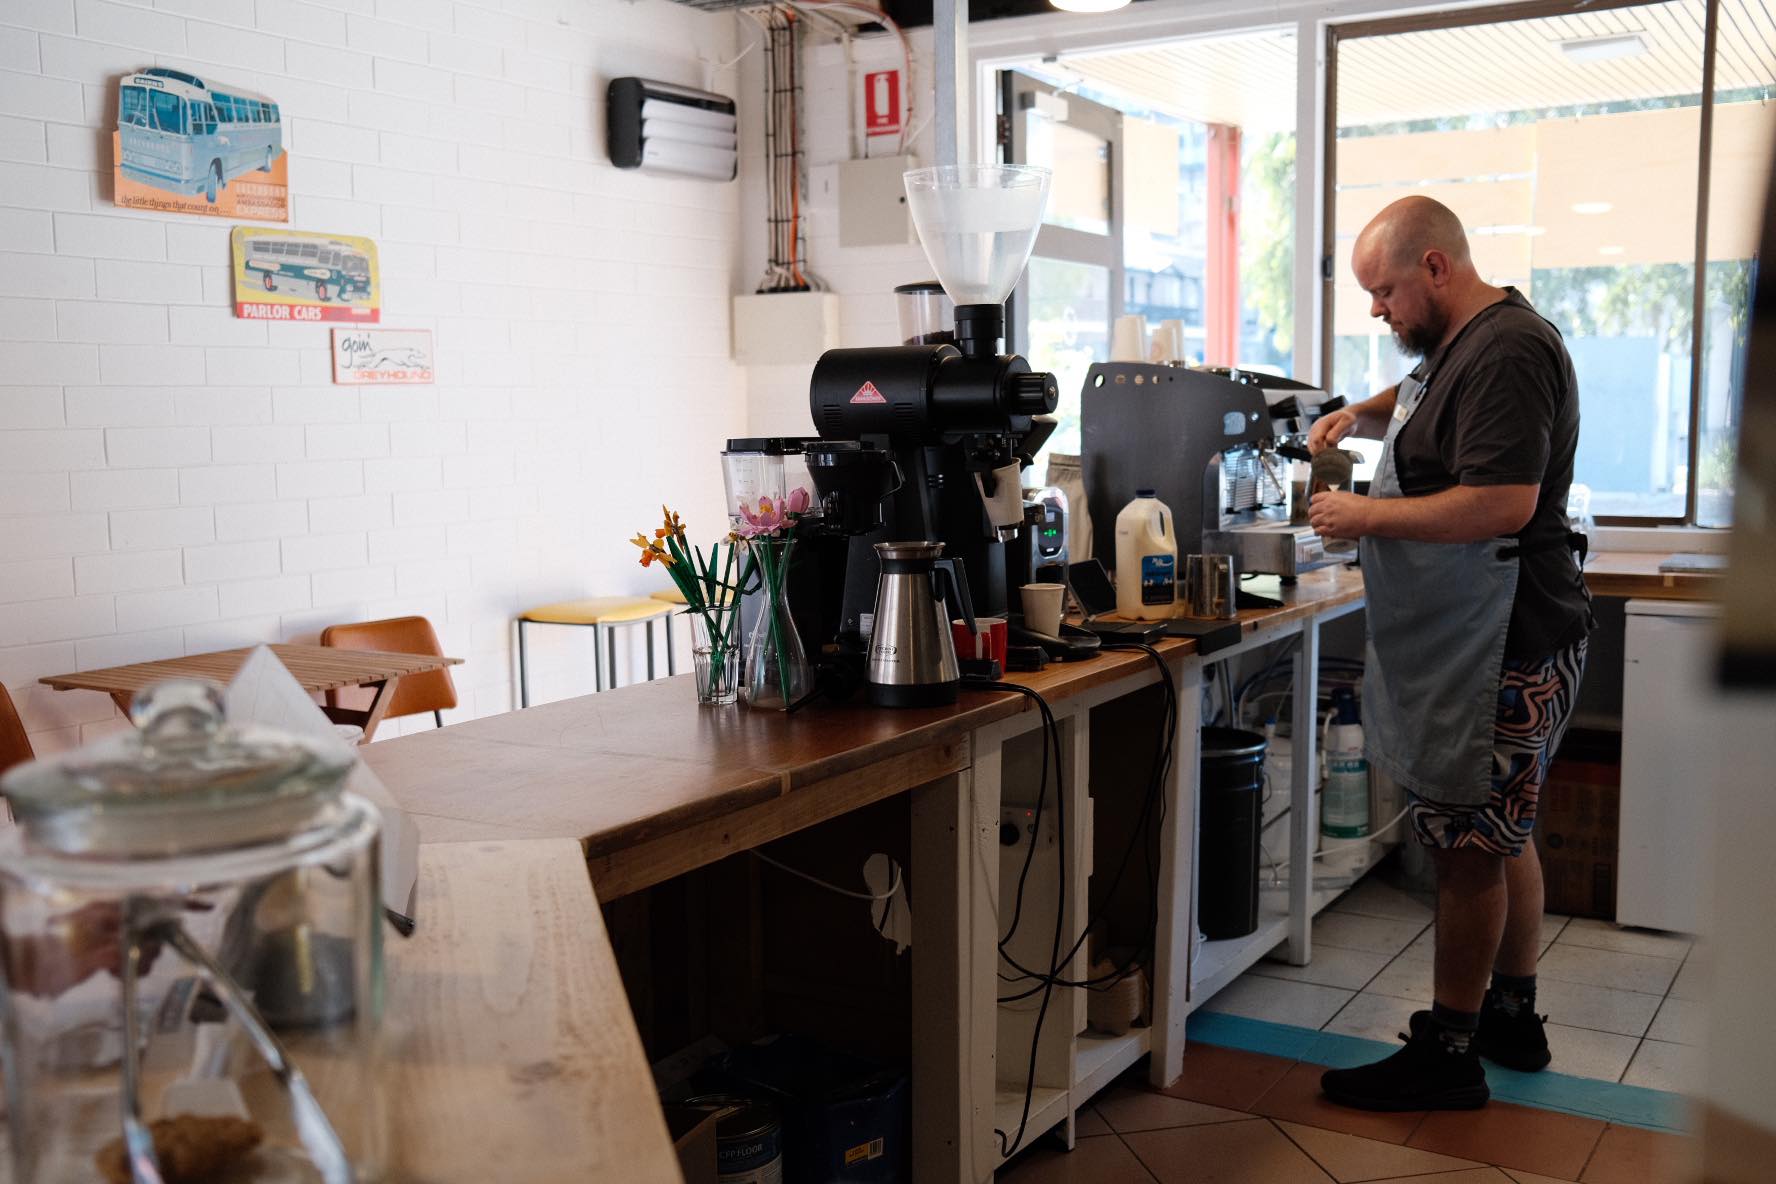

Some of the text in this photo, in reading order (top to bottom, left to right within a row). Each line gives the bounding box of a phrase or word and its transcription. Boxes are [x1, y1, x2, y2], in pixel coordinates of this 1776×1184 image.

[121, 195, 132, 206] the
[133, 196, 149, 206] little
[172, 199, 187, 209] that
[243, 303, 322, 320] PARLOR CARS
